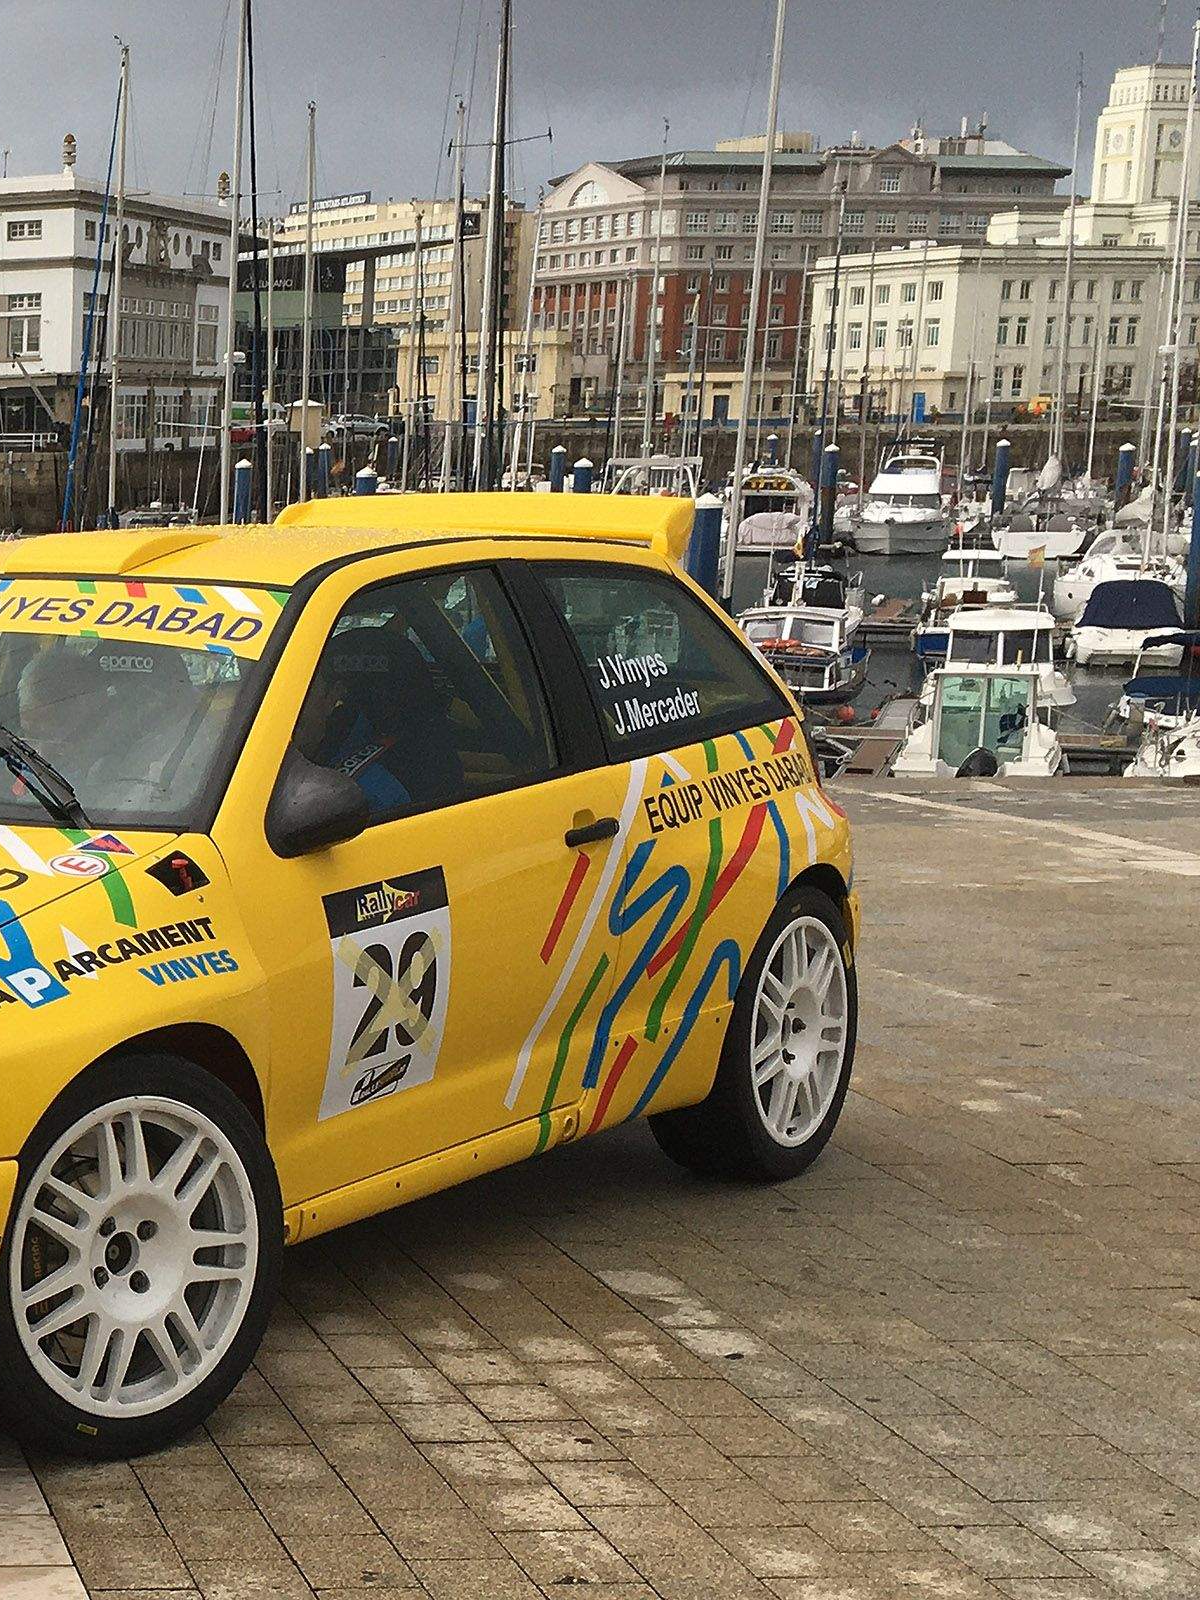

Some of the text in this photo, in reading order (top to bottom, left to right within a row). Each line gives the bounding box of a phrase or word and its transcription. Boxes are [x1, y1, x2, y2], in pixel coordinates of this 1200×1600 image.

[93, 600, 265, 642] DABAD
[100, 655, 153, 672] sparco
[597, 651, 668, 690] J.Vinyes
[614, 687, 701, 736] J.Mercader
[644, 784, 703, 834] EQUIP
[702, 764, 771, 813] VINYES
[137, 949, 239, 986] VINYES
